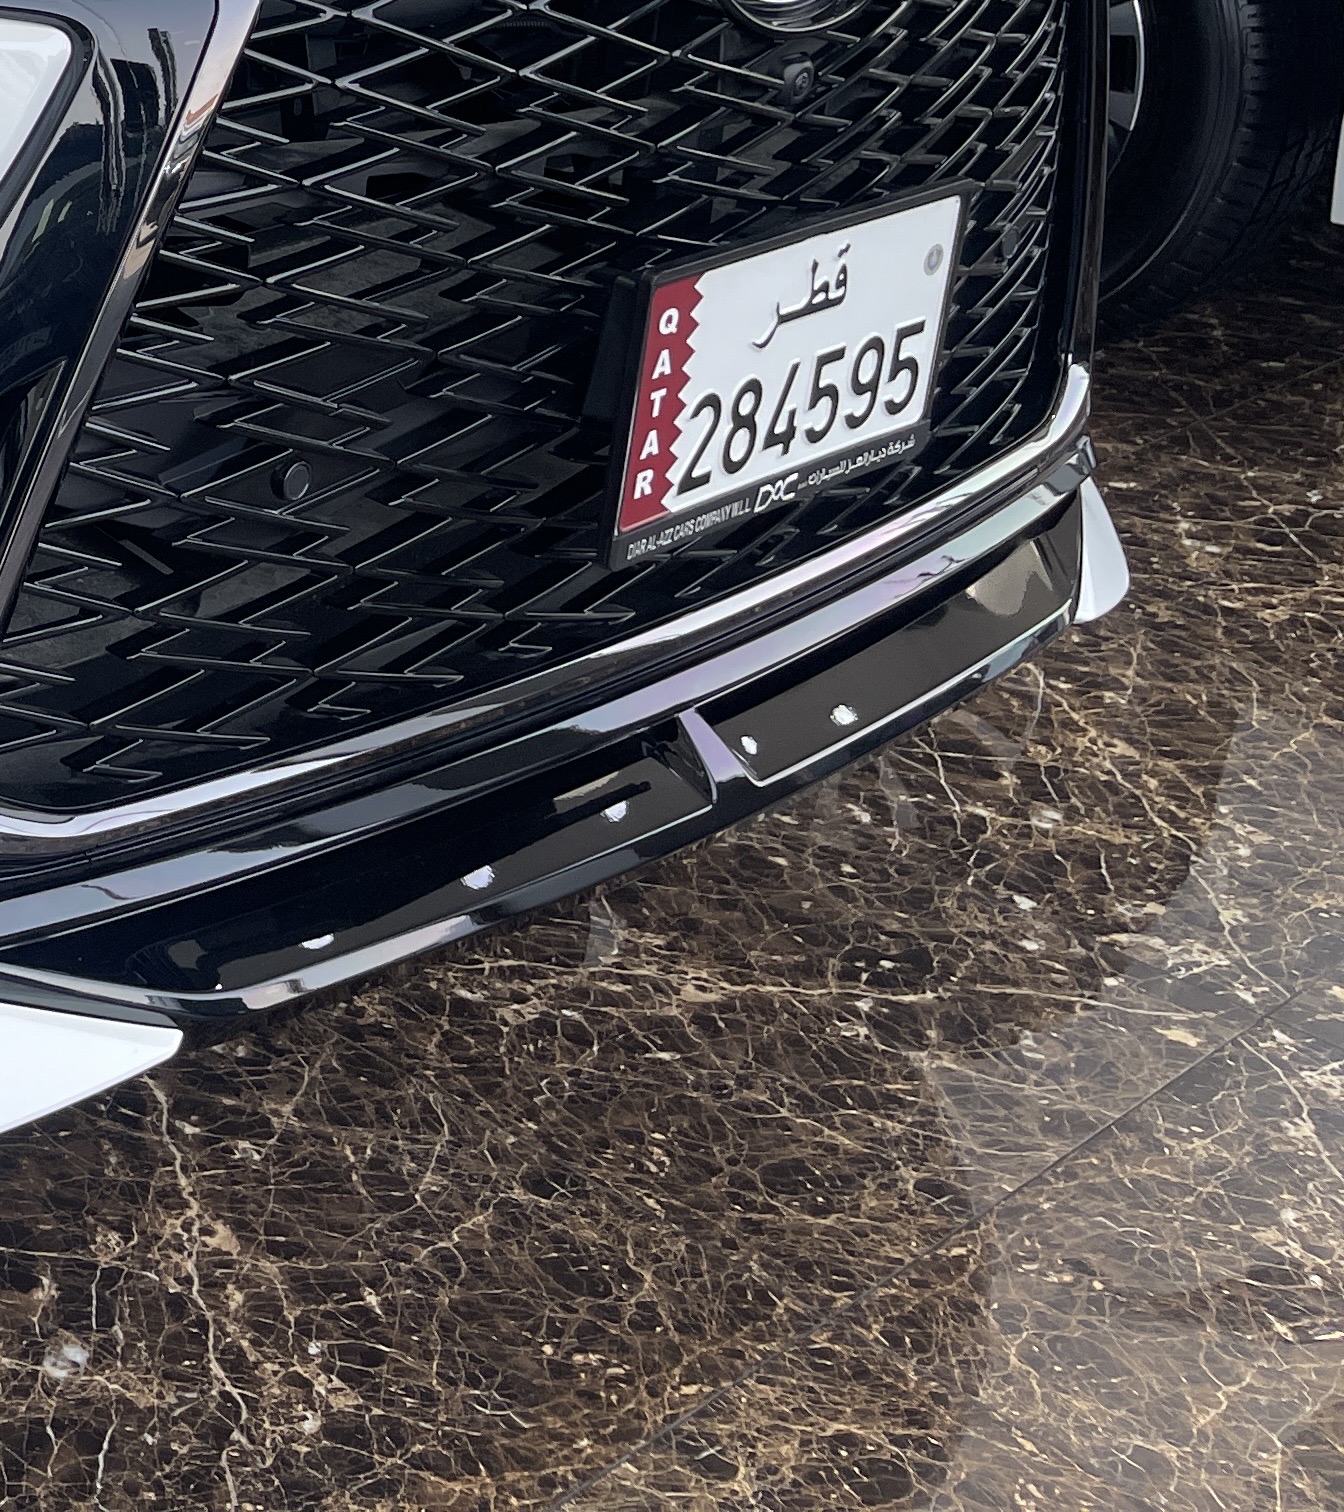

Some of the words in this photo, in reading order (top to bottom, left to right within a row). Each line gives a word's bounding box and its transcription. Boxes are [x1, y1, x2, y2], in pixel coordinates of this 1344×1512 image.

[753, 241, 852, 349] قطر
[632, 306, 680, 501] QATAR
[675, 315, 927, 497] 284595
[887, 433, 916, 456] شركة
[626, 539, 648, 561] DIAR
[646, 527, 673, 551] AL-AZZ
[673, 519, 695, 541] CARS
[694, 503, 732, 533] COMPANY
